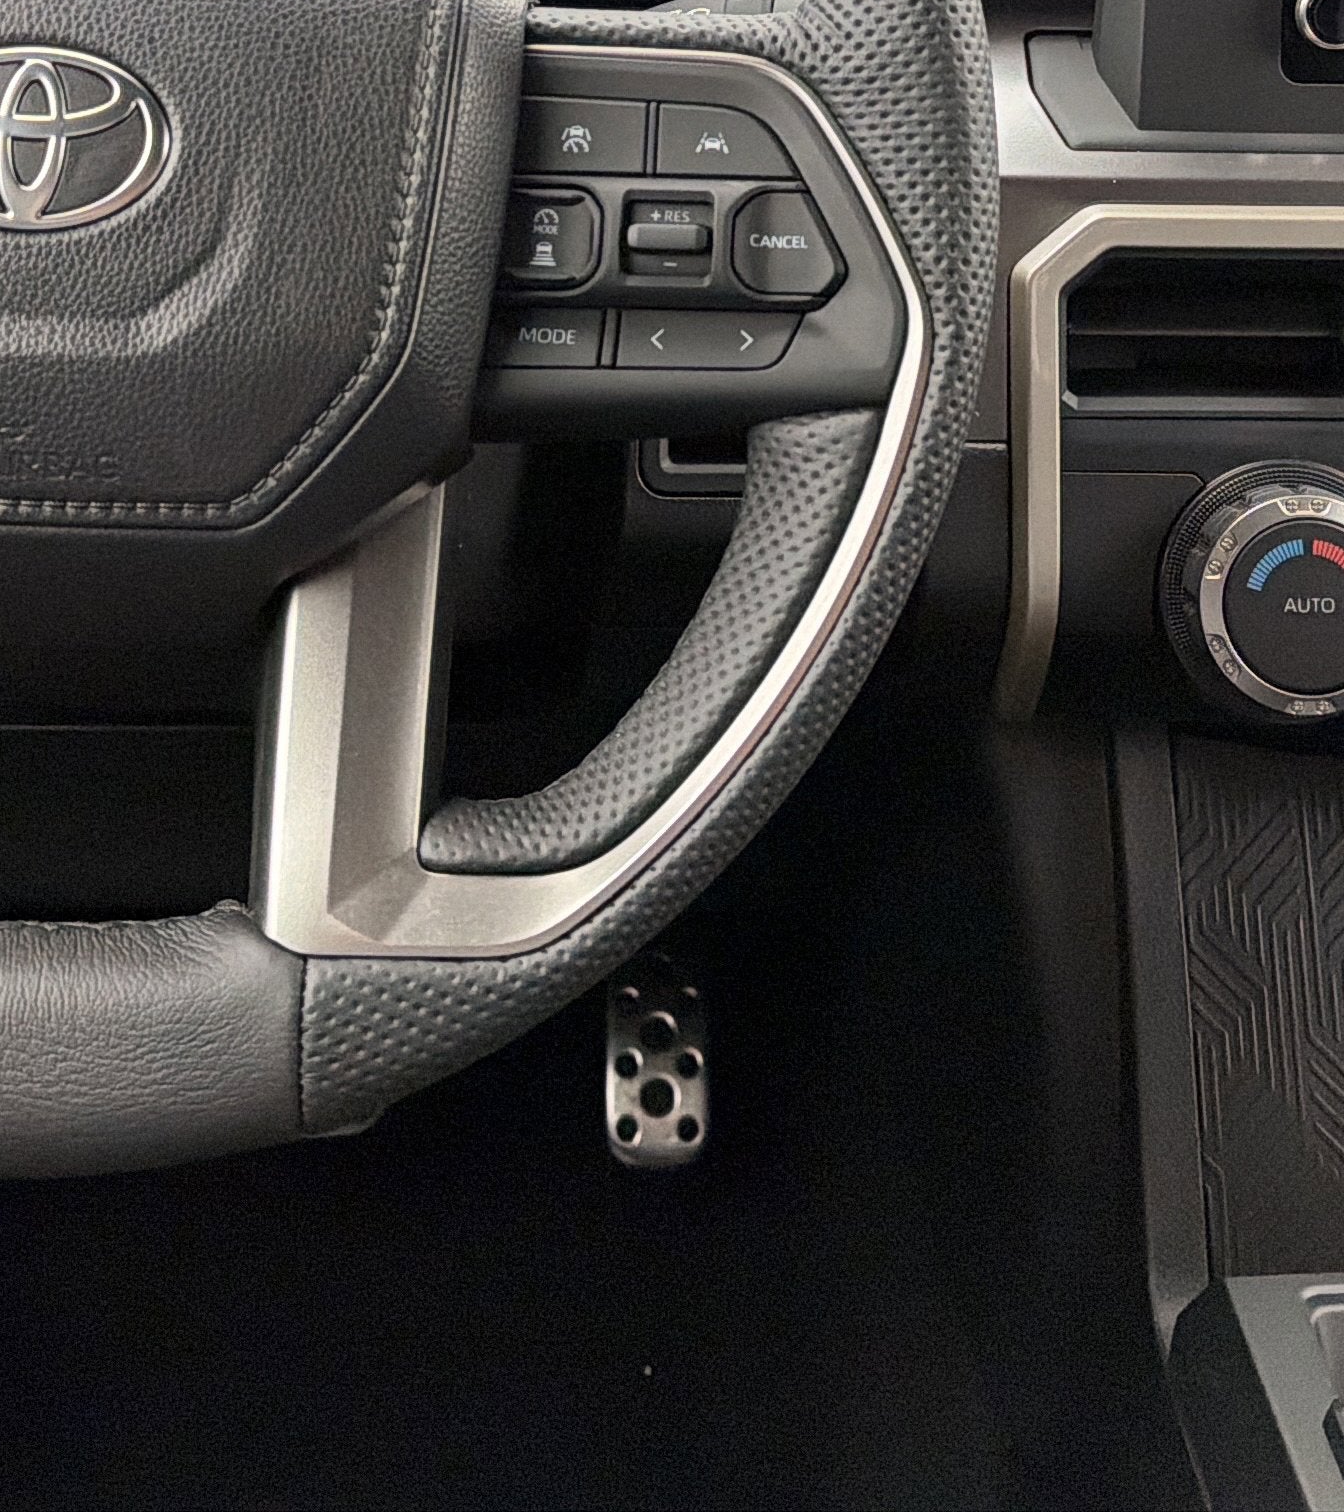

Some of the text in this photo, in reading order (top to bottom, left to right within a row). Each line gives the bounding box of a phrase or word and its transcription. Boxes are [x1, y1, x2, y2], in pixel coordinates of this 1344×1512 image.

[749, 232, 808, 250] CANCEL
[518, 326, 576, 346] MODE
[1283, 597, 1336, 614] AUTO
